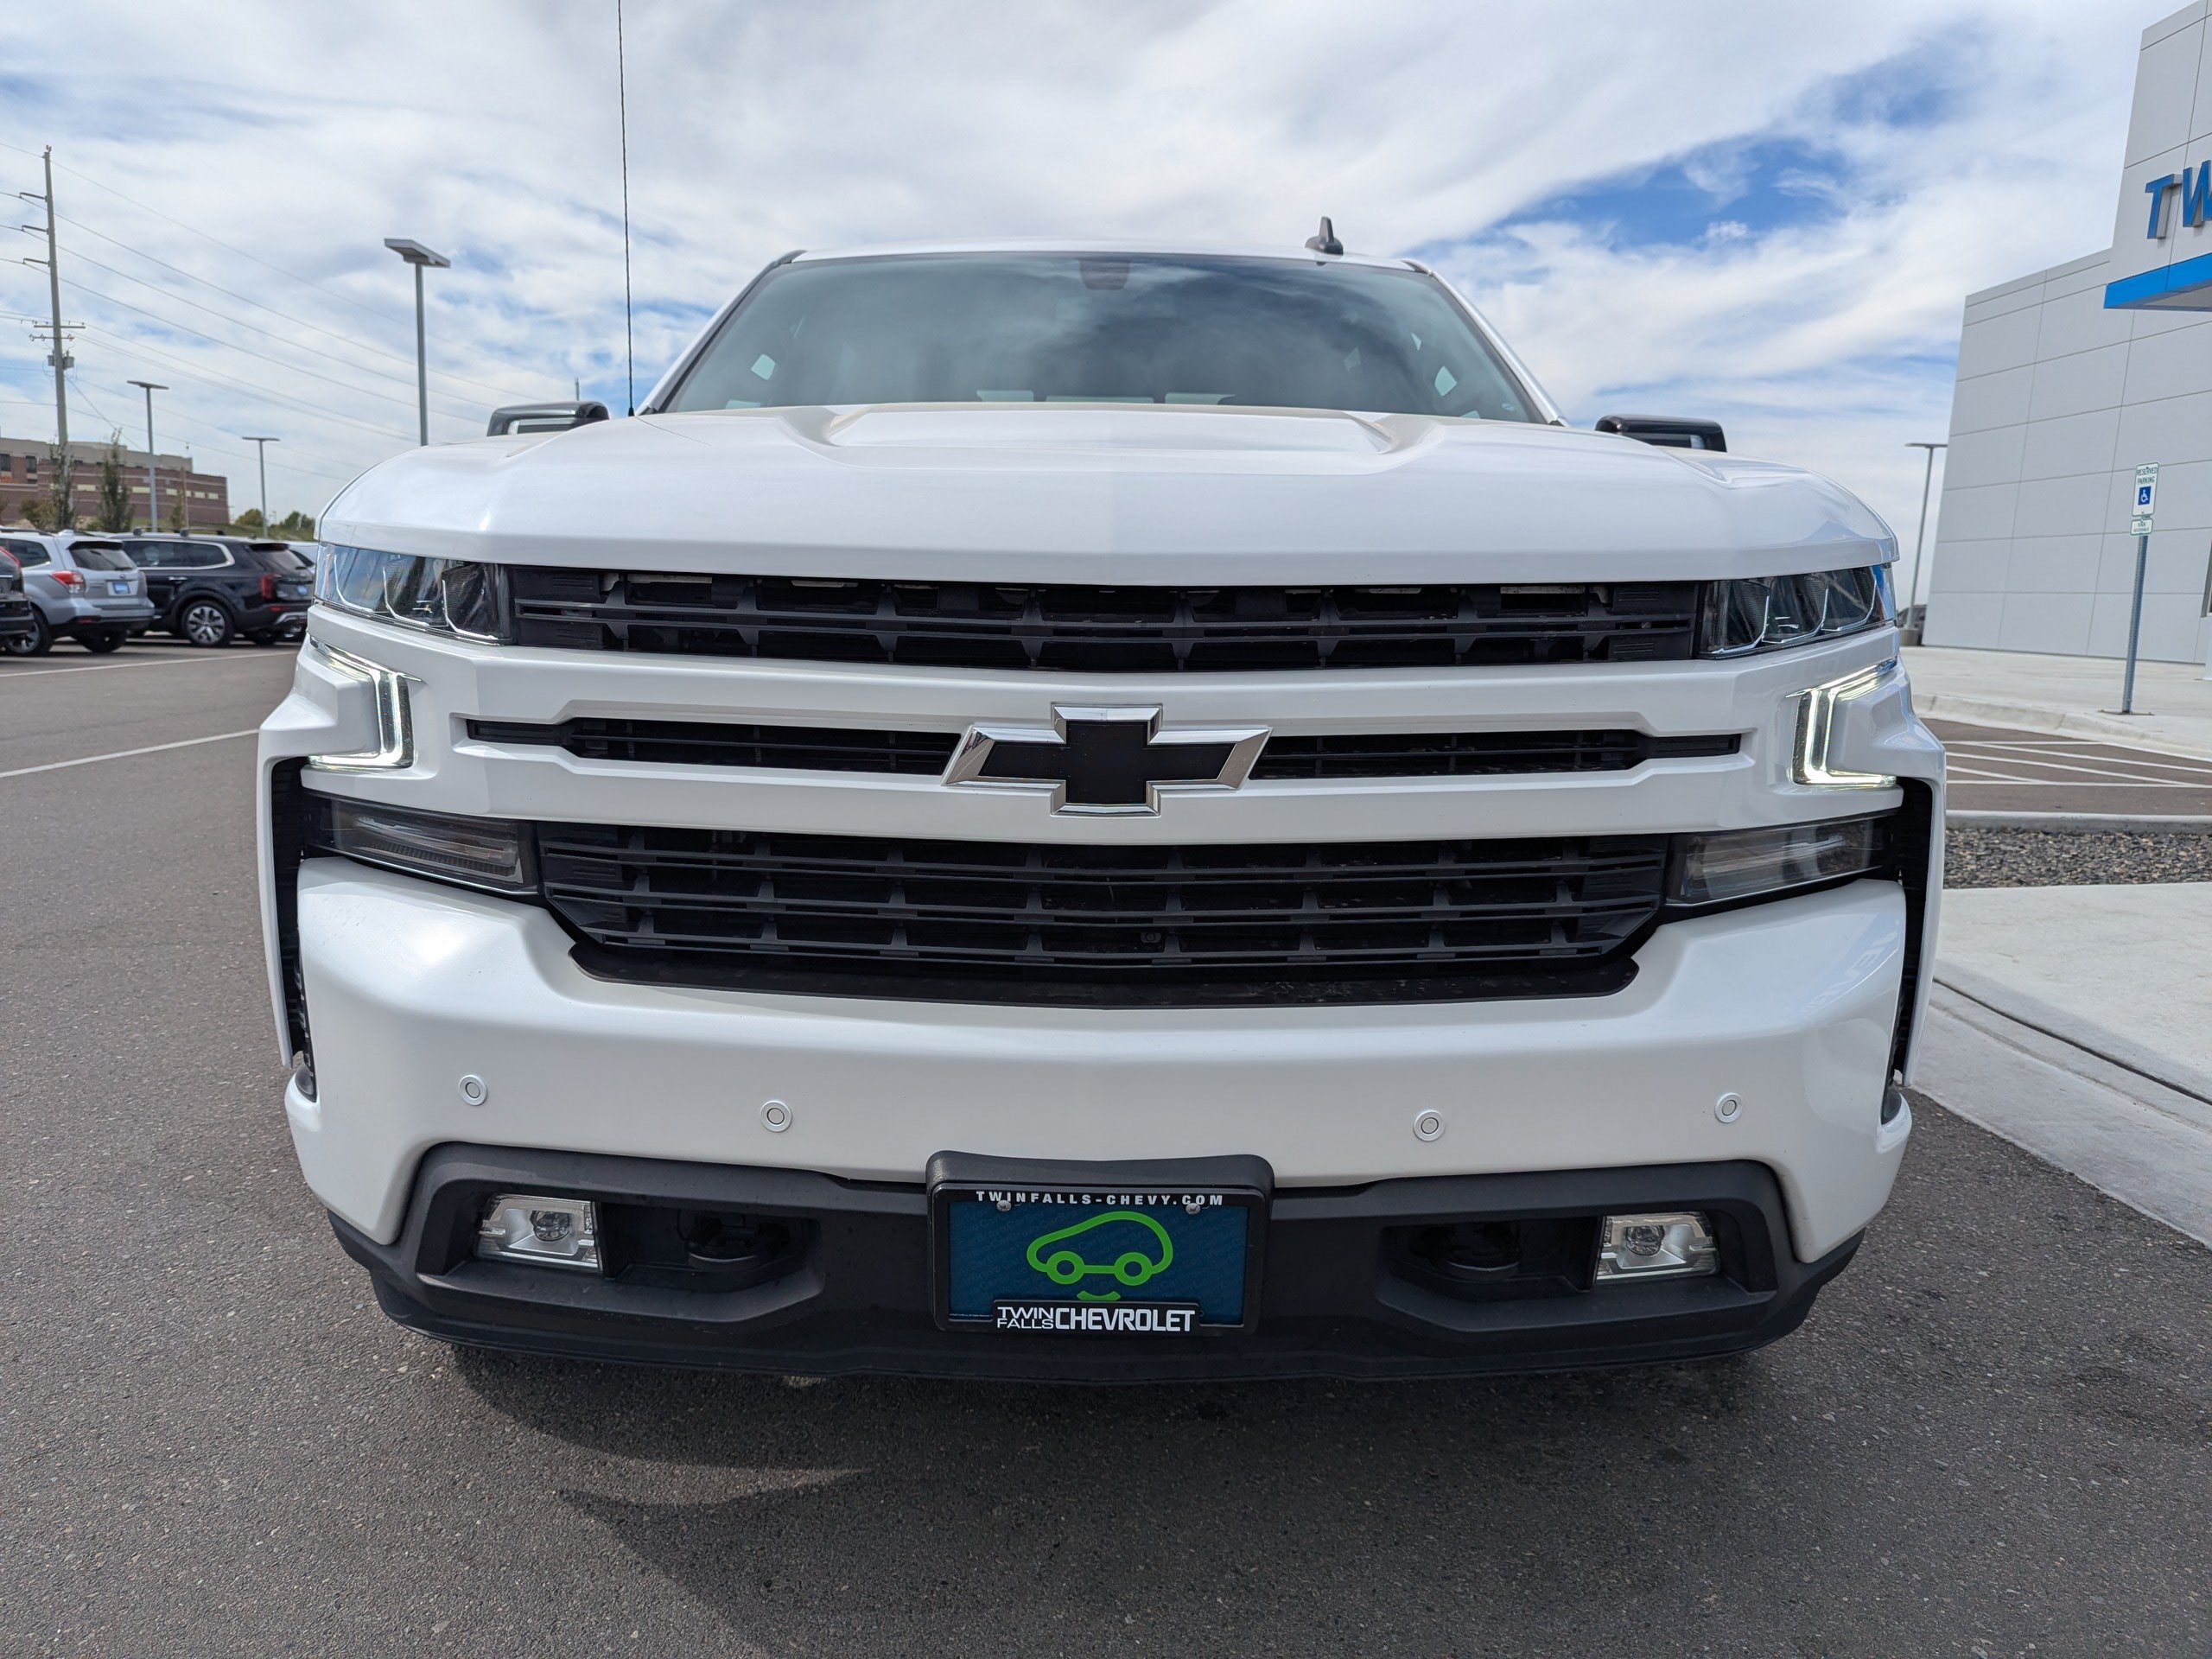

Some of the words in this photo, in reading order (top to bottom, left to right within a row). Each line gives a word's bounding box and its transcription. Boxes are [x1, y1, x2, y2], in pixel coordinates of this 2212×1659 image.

[976, 1191, 1224, 1206] TWINFALLS-CHEVY.COM
[997, 1306, 1054, 1319] TWIN
[1055, 1307, 1196, 1332] CHEVROLET
[996, 1318, 1054, 1329] FALLS
